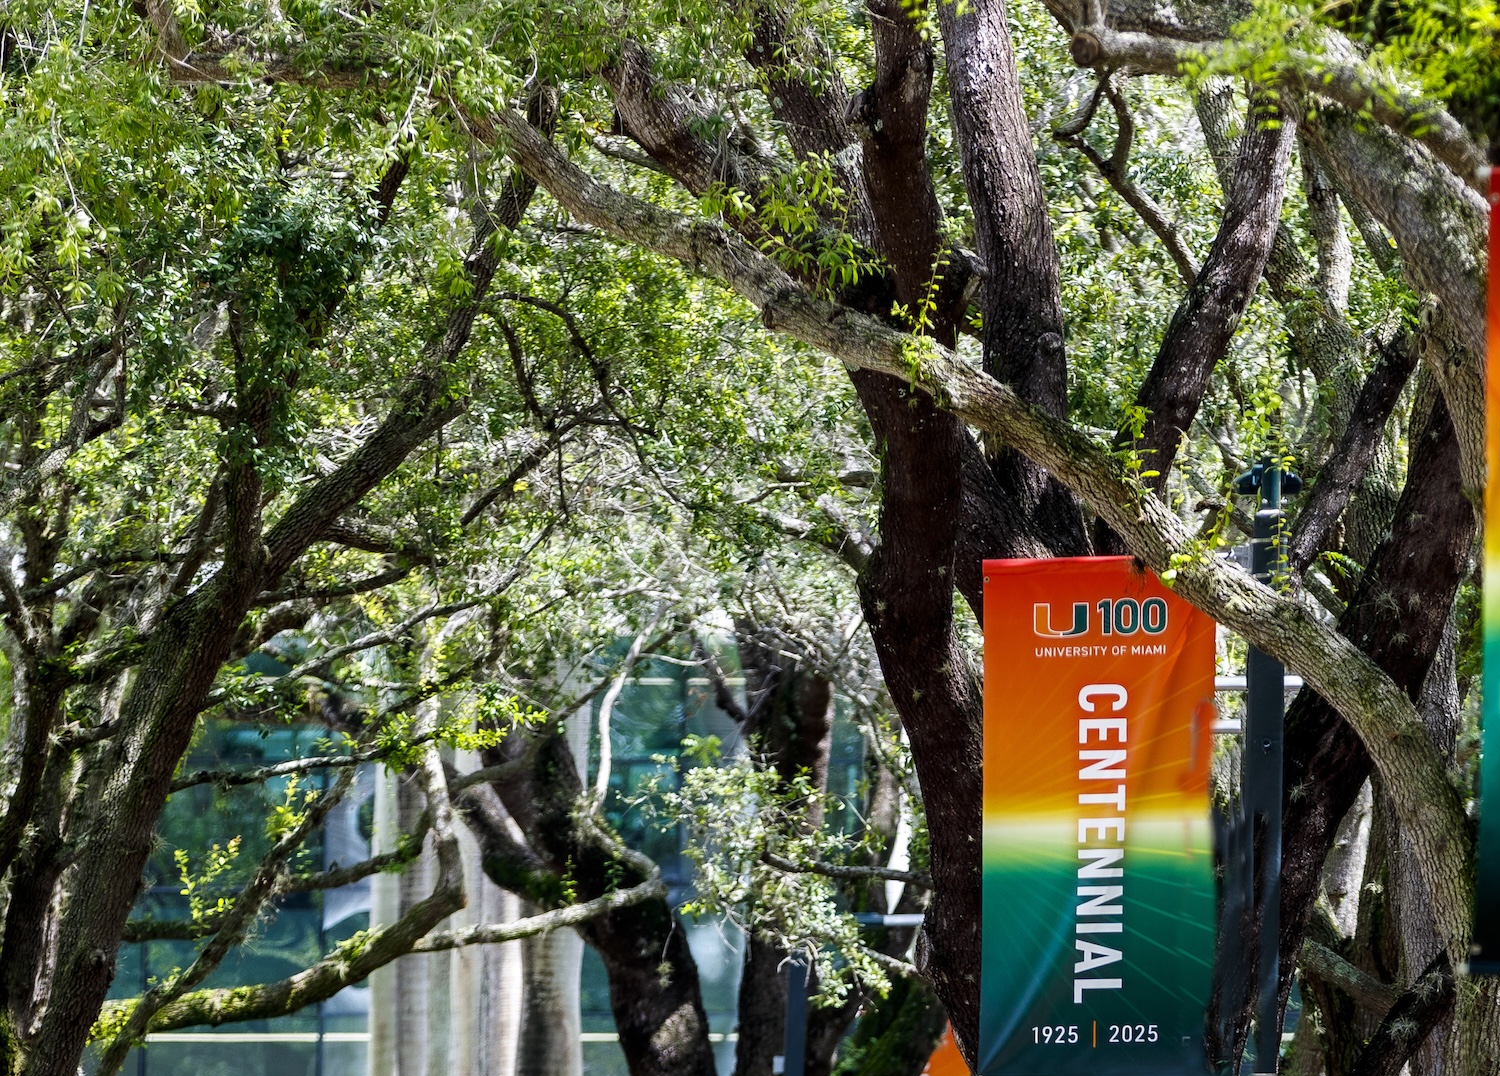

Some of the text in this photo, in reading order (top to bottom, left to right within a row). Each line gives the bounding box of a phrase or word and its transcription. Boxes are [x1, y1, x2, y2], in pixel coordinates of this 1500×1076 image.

[1034, 597, 1168, 638] U 100
[1035, 645, 1166, 657] UNIVERSITY OF MIAMI
[1074, 684, 1128, 1003] CENTENNIAL
[1032, 1024, 1159, 1044] 1925 2025
